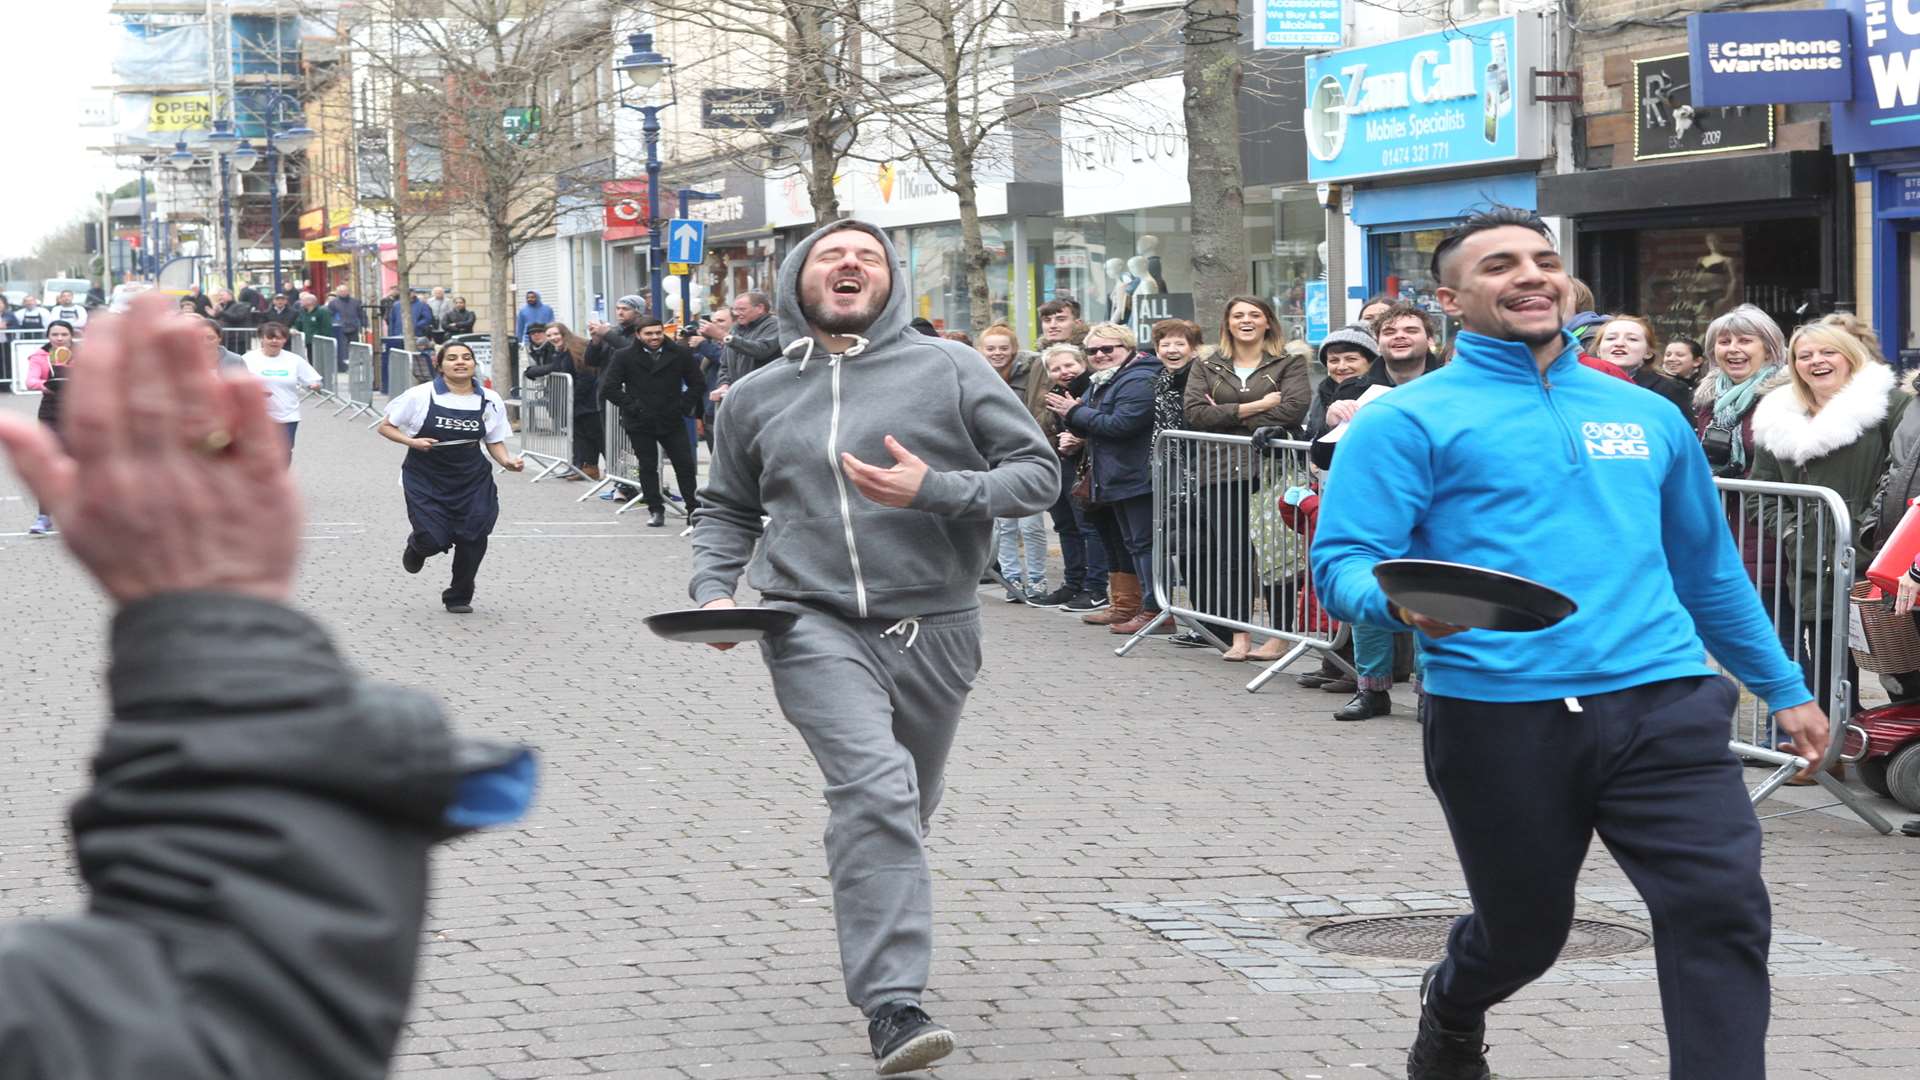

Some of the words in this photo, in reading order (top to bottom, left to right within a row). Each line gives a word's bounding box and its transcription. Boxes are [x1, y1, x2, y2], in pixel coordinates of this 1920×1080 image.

[1280, 21, 1326, 29] Mobiles
[1721, 39, 1841, 58] Carphone
[1410, 38, 1478, 104] Call
[1710, 56, 1842, 73] Warehouse
[155, 101, 210, 114] OPEN
[1366, 118, 1406, 142] Mobiles
[1409, 109, 1466, 138] Specialists
[1130, 121, 1187, 163] LOO
[1702, 130, 1722, 145] 2009
[1382, 148, 1410, 167] 01474
[1412, 145, 1429, 163] 321
[1431, 141, 1449, 160] 771
[1139, 299, 1173, 319] ALL
[435, 416, 480, 428] TESCO
[1585, 439, 1649, 455] NRG
